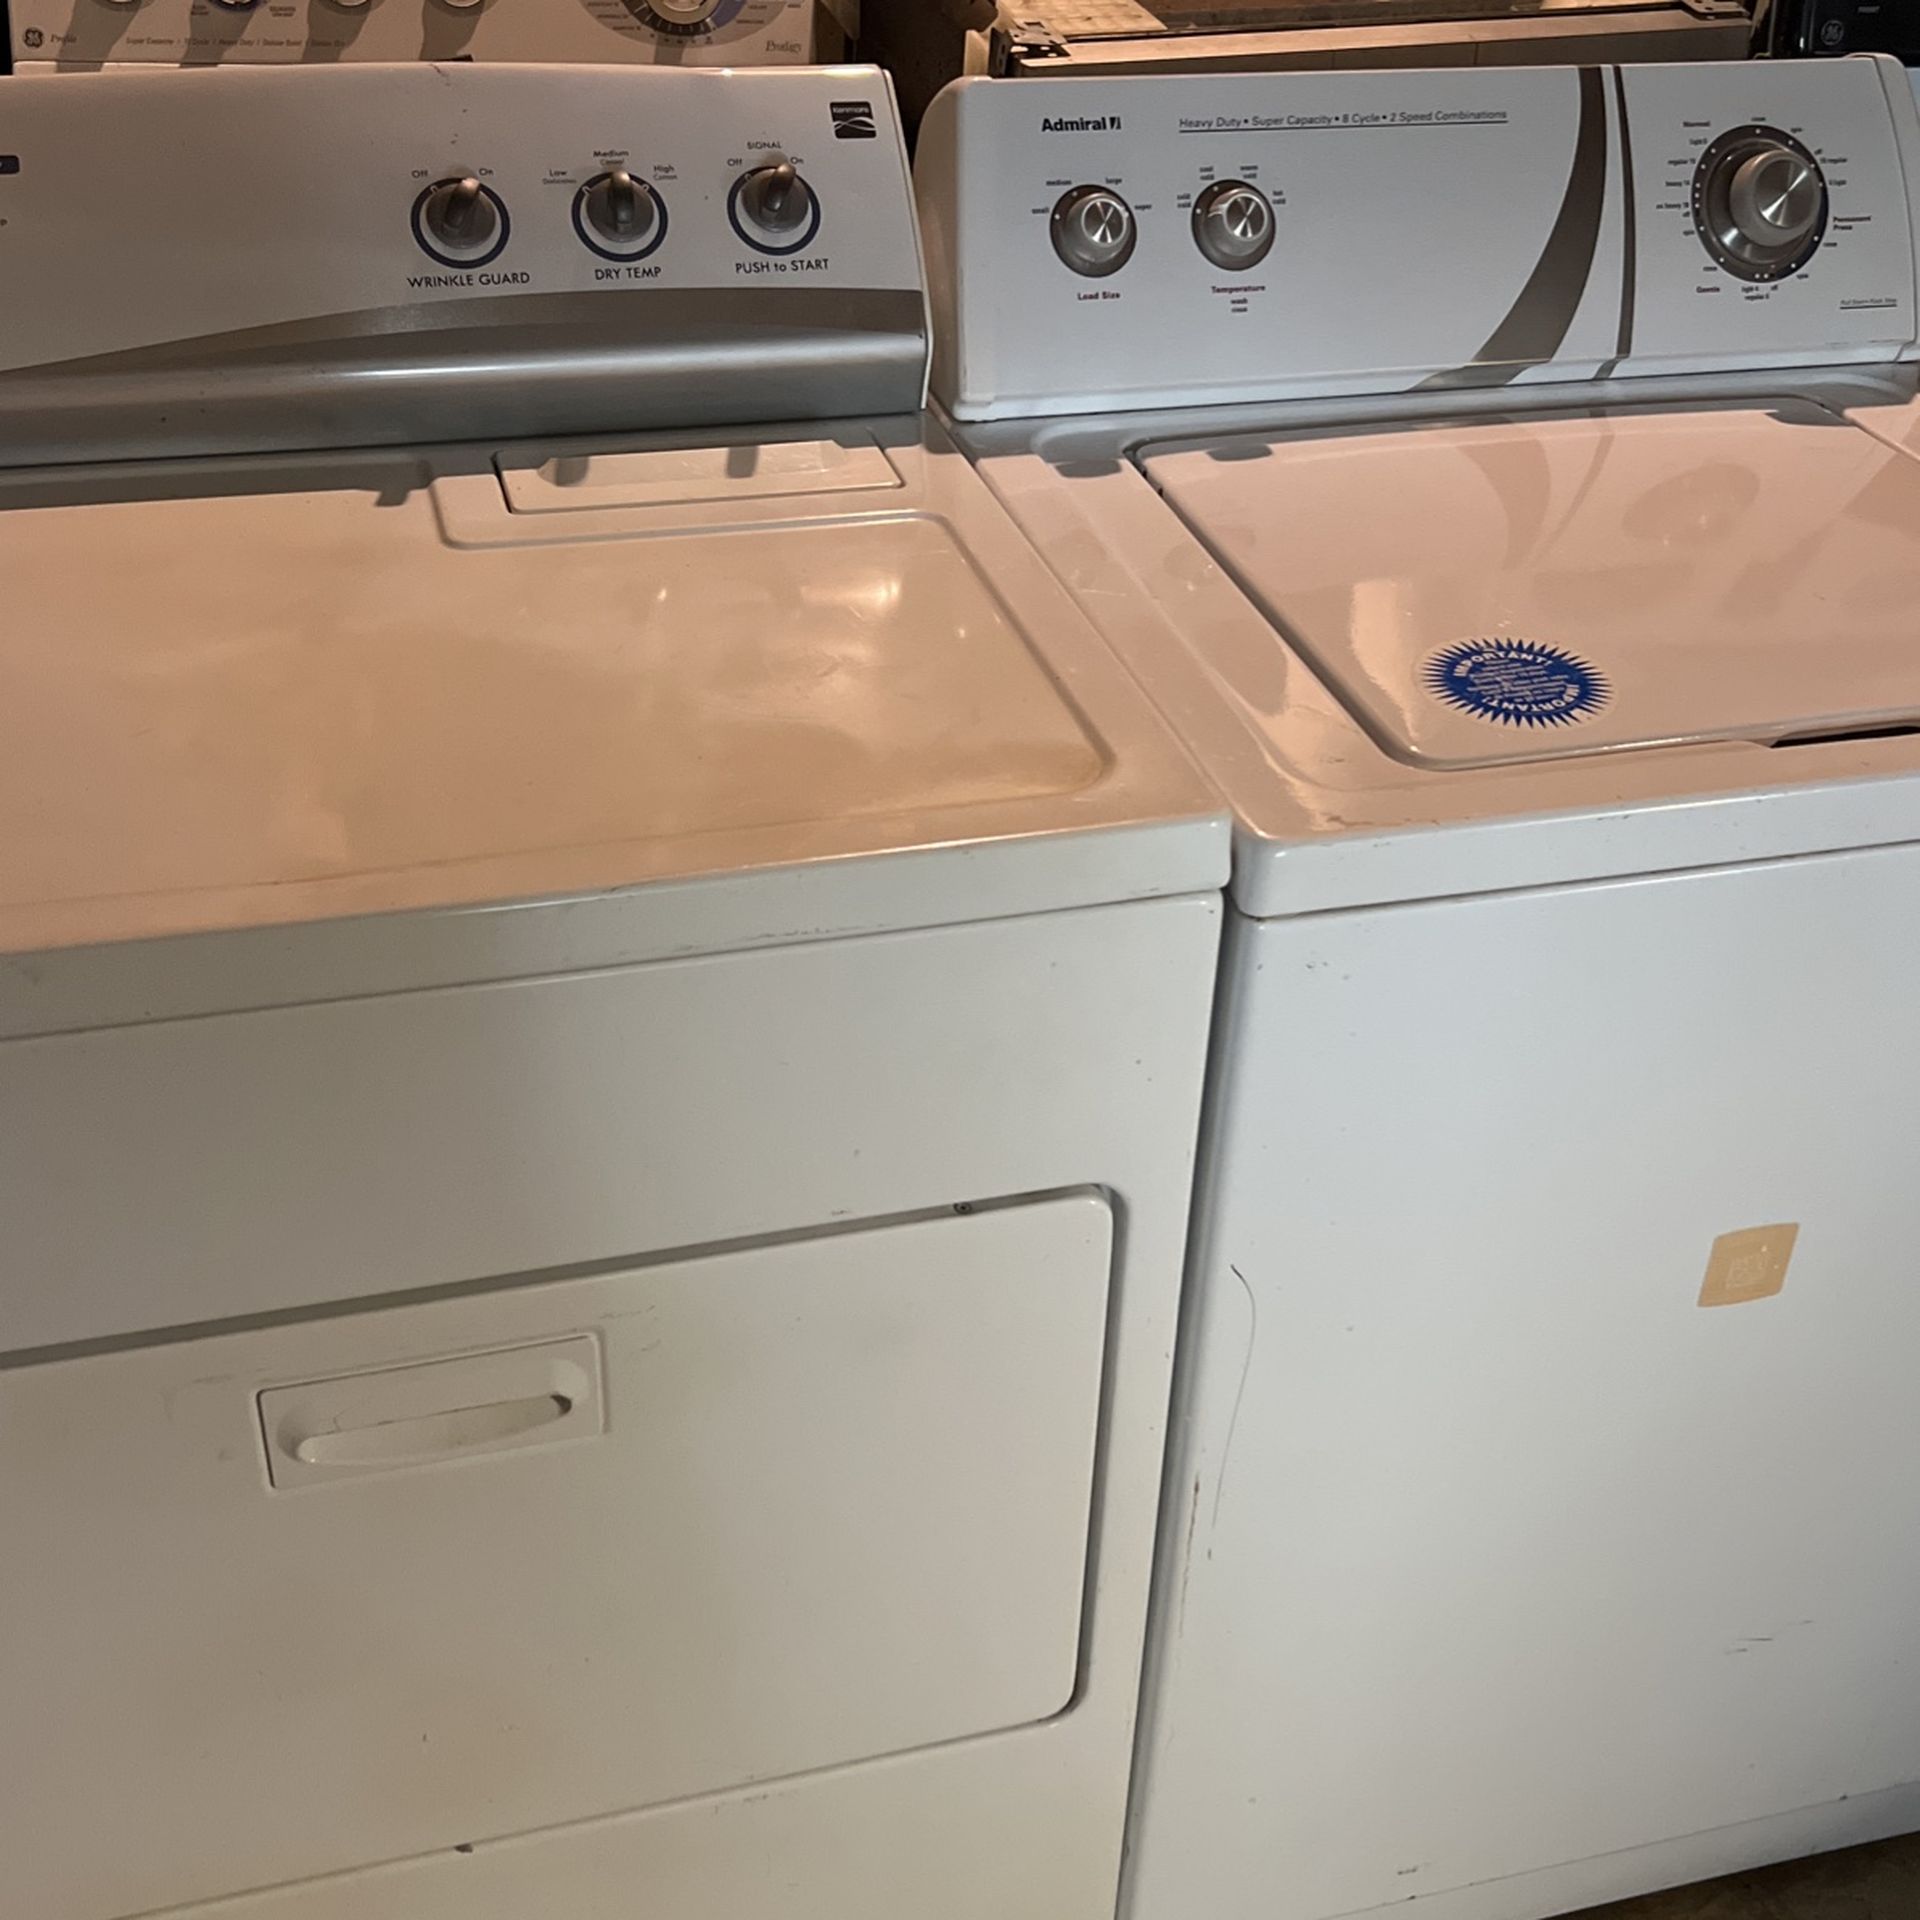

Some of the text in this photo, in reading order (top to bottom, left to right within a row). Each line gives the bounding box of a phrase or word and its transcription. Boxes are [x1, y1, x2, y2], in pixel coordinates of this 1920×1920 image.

[1042, 116, 1107, 132] Admiral
[1179, 117, 1213, 130] Heavy
[1216, 116, 1241, 129] Duty
[1252, 115, 1284, 128] Super
[1287, 114, 1333, 127] Capacity
[1351, 113, 1380, 125] Cycle
[1390, 112, 1397, 123] 2
[1400, 111, 1432, 124] Speed
[1434, 110, 1507, 122] Combinations
[747, 140, 782, 149] SIGNAL
[593, 149, 629, 159] Medium
[727, 157, 743, 167] Off
[790, 155, 804, 165] On
[411, 169, 428, 179] Off
[479, 167, 494, 176] On
[549, 168, 568, 178] Low
[653, 164, 675, 174] High
[735, 258, 829, 274] PUSH to START
[594, 266, 661, 280] DRY TEMP
[407, 271, 530, 288] WRINKLE GUARD
[1211, 284, 1265, 294] Temperature
[1077, 291, 1120, 300] Load Size
[1453, 650, 1552, 677] IMPORTANT!
[1481, 684, 1580, 711] IMPORTANT!
